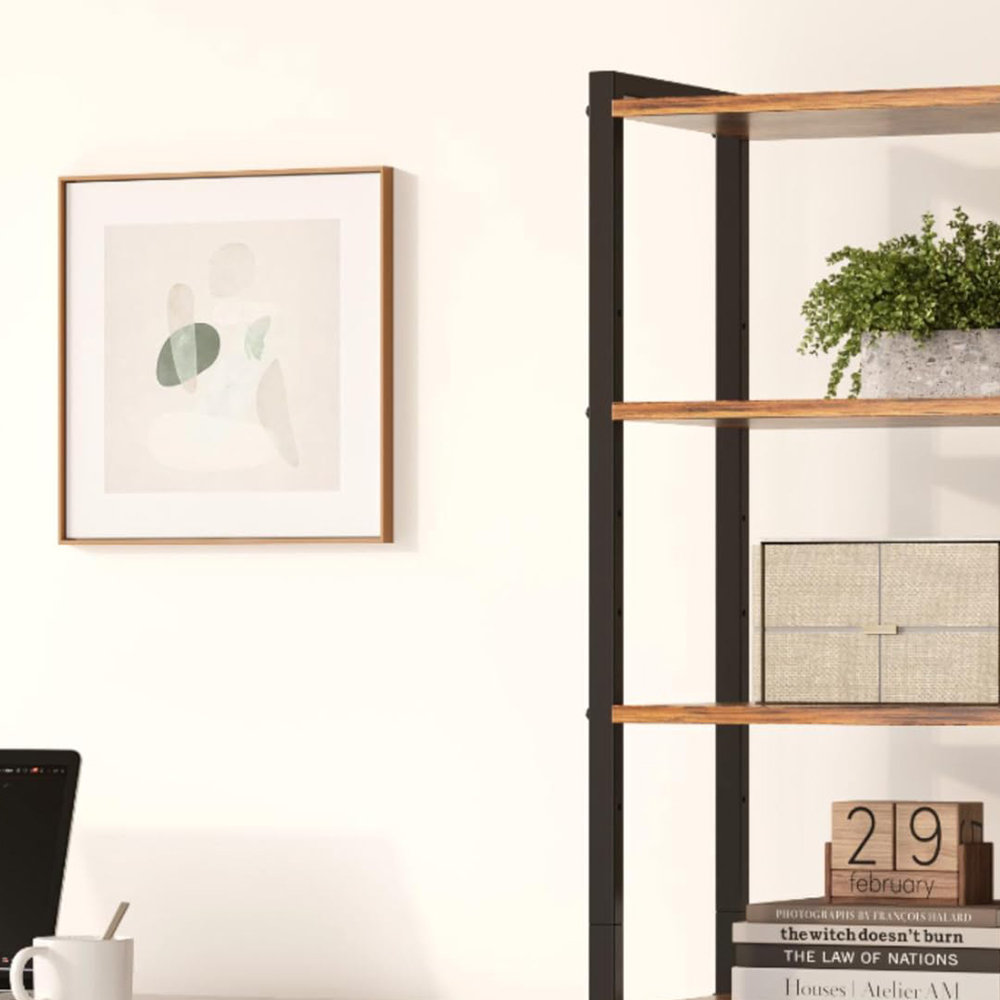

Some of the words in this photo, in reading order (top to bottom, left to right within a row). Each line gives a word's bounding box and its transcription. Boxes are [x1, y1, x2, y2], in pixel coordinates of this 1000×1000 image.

[850, 871, 935, 899] february
[775, 908, 855, 921] PHOTOGRAPHS
[858, 910, 870, 921] BY
[928, 912, 972, 923] HALARD
[780, 926, 808, 941] the
[809, 927, 857, 942] witch
[923, 929, 964, 944] burn
[784, 949, 816, 963] THE
[822, 951, 855, 964] LAW
[860, 952, 882, 965] OF
[888, 952, 958, 966] NATIONS
[785, 977, 846, 997] Houses
[864, 980, 923, 999] Atelier
